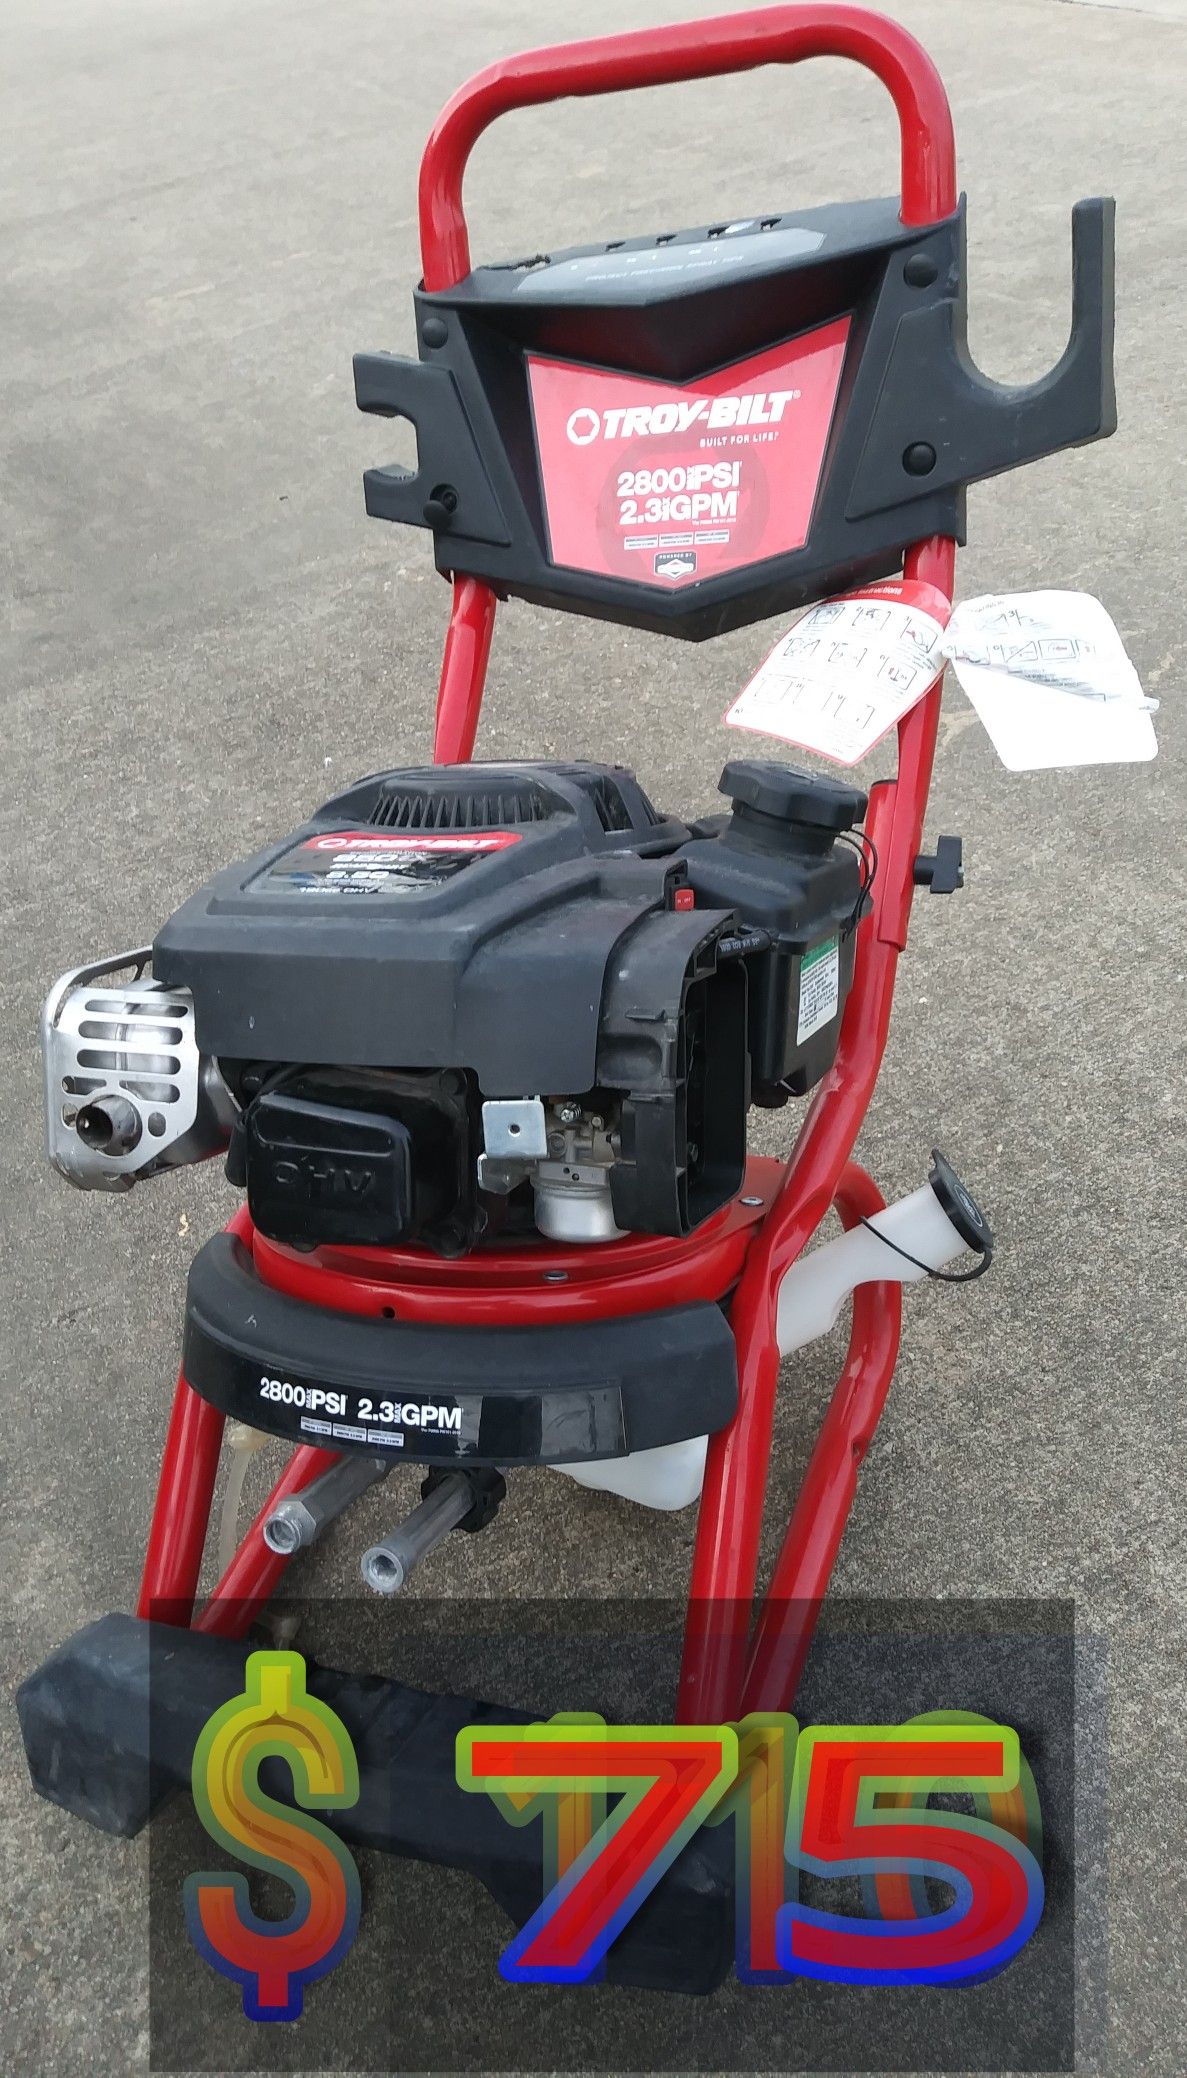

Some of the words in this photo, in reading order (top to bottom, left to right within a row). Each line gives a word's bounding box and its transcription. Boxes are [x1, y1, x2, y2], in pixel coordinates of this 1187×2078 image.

[603, 390, 794, 440] TROY-BILT
[699, 435, 727, 448] BUILT
[730, 434, 750, 445] FOR
[617, 466, 686, 497] 2800
[274, 1160, 372, 1195] OHV
[259, 1377, 306, 1407] 2800
[311, 1388, 347, 1416] PSI
[357, 1398, 395, 1423] 2.3
[401, 1403, 462, 1429] GPM
